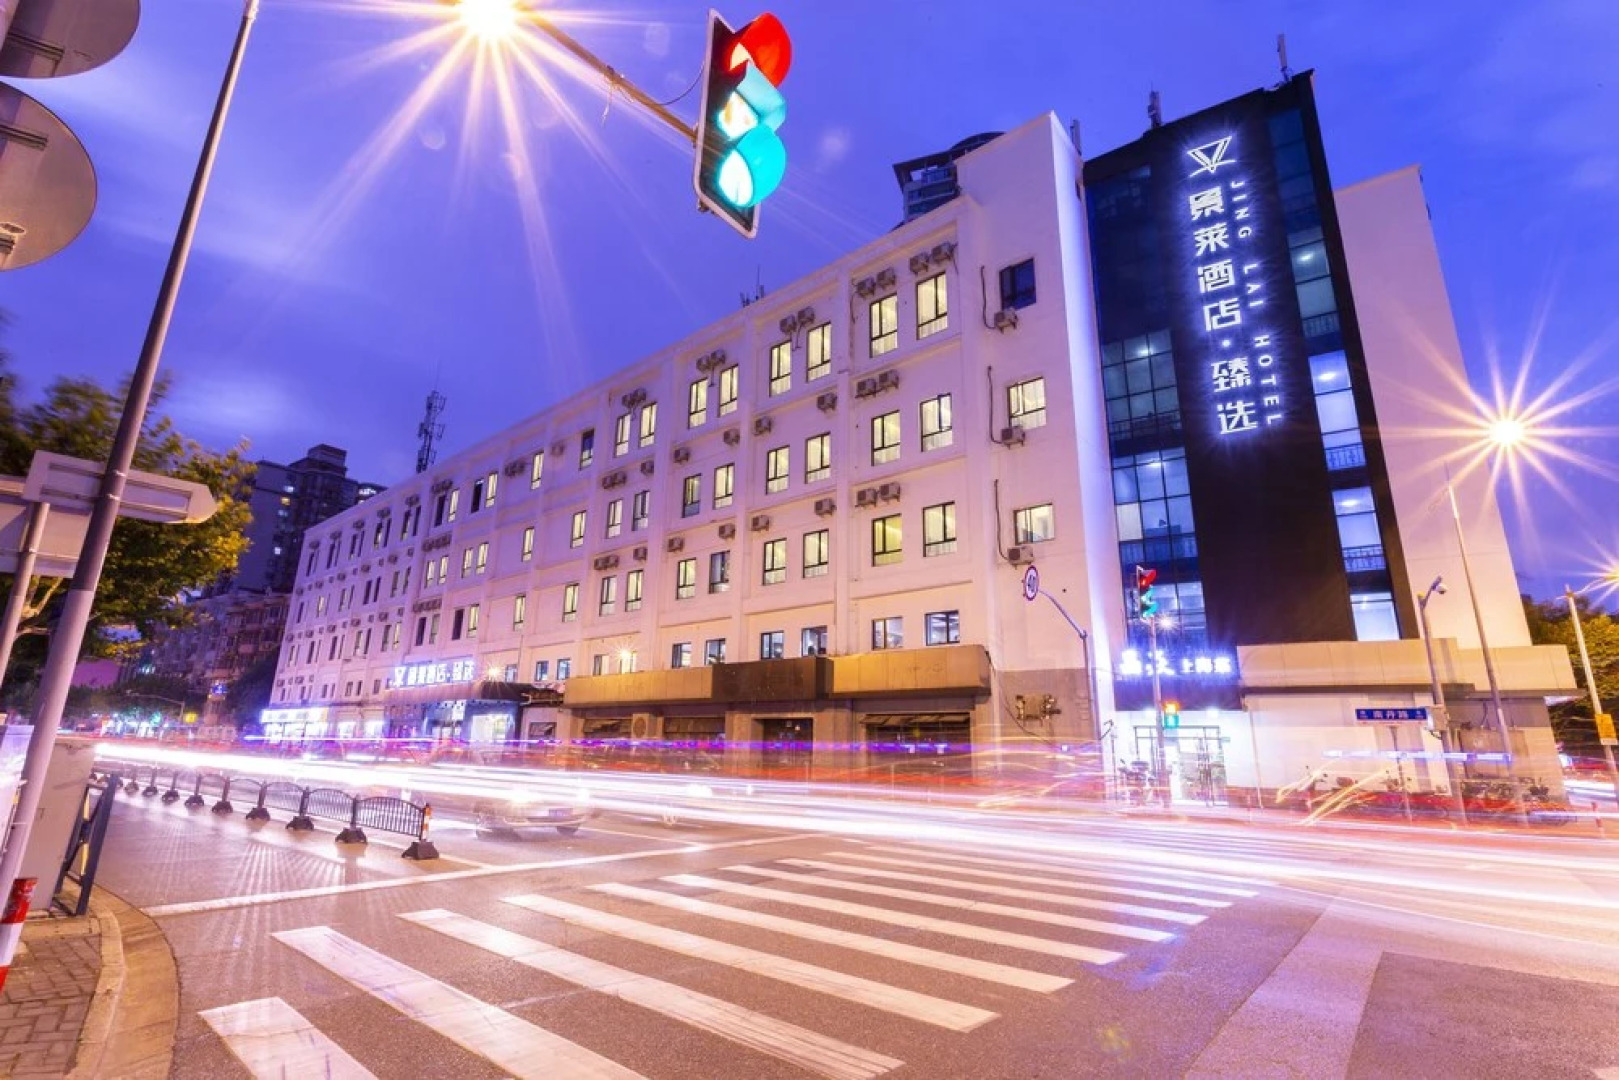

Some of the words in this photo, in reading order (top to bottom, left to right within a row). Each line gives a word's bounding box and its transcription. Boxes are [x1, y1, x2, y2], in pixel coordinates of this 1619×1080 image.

[1230, 180, 1253, 239] JING
[1243, 263, 1265, 308] LAI
[1254, 335, 1282, 425] HOTEL
